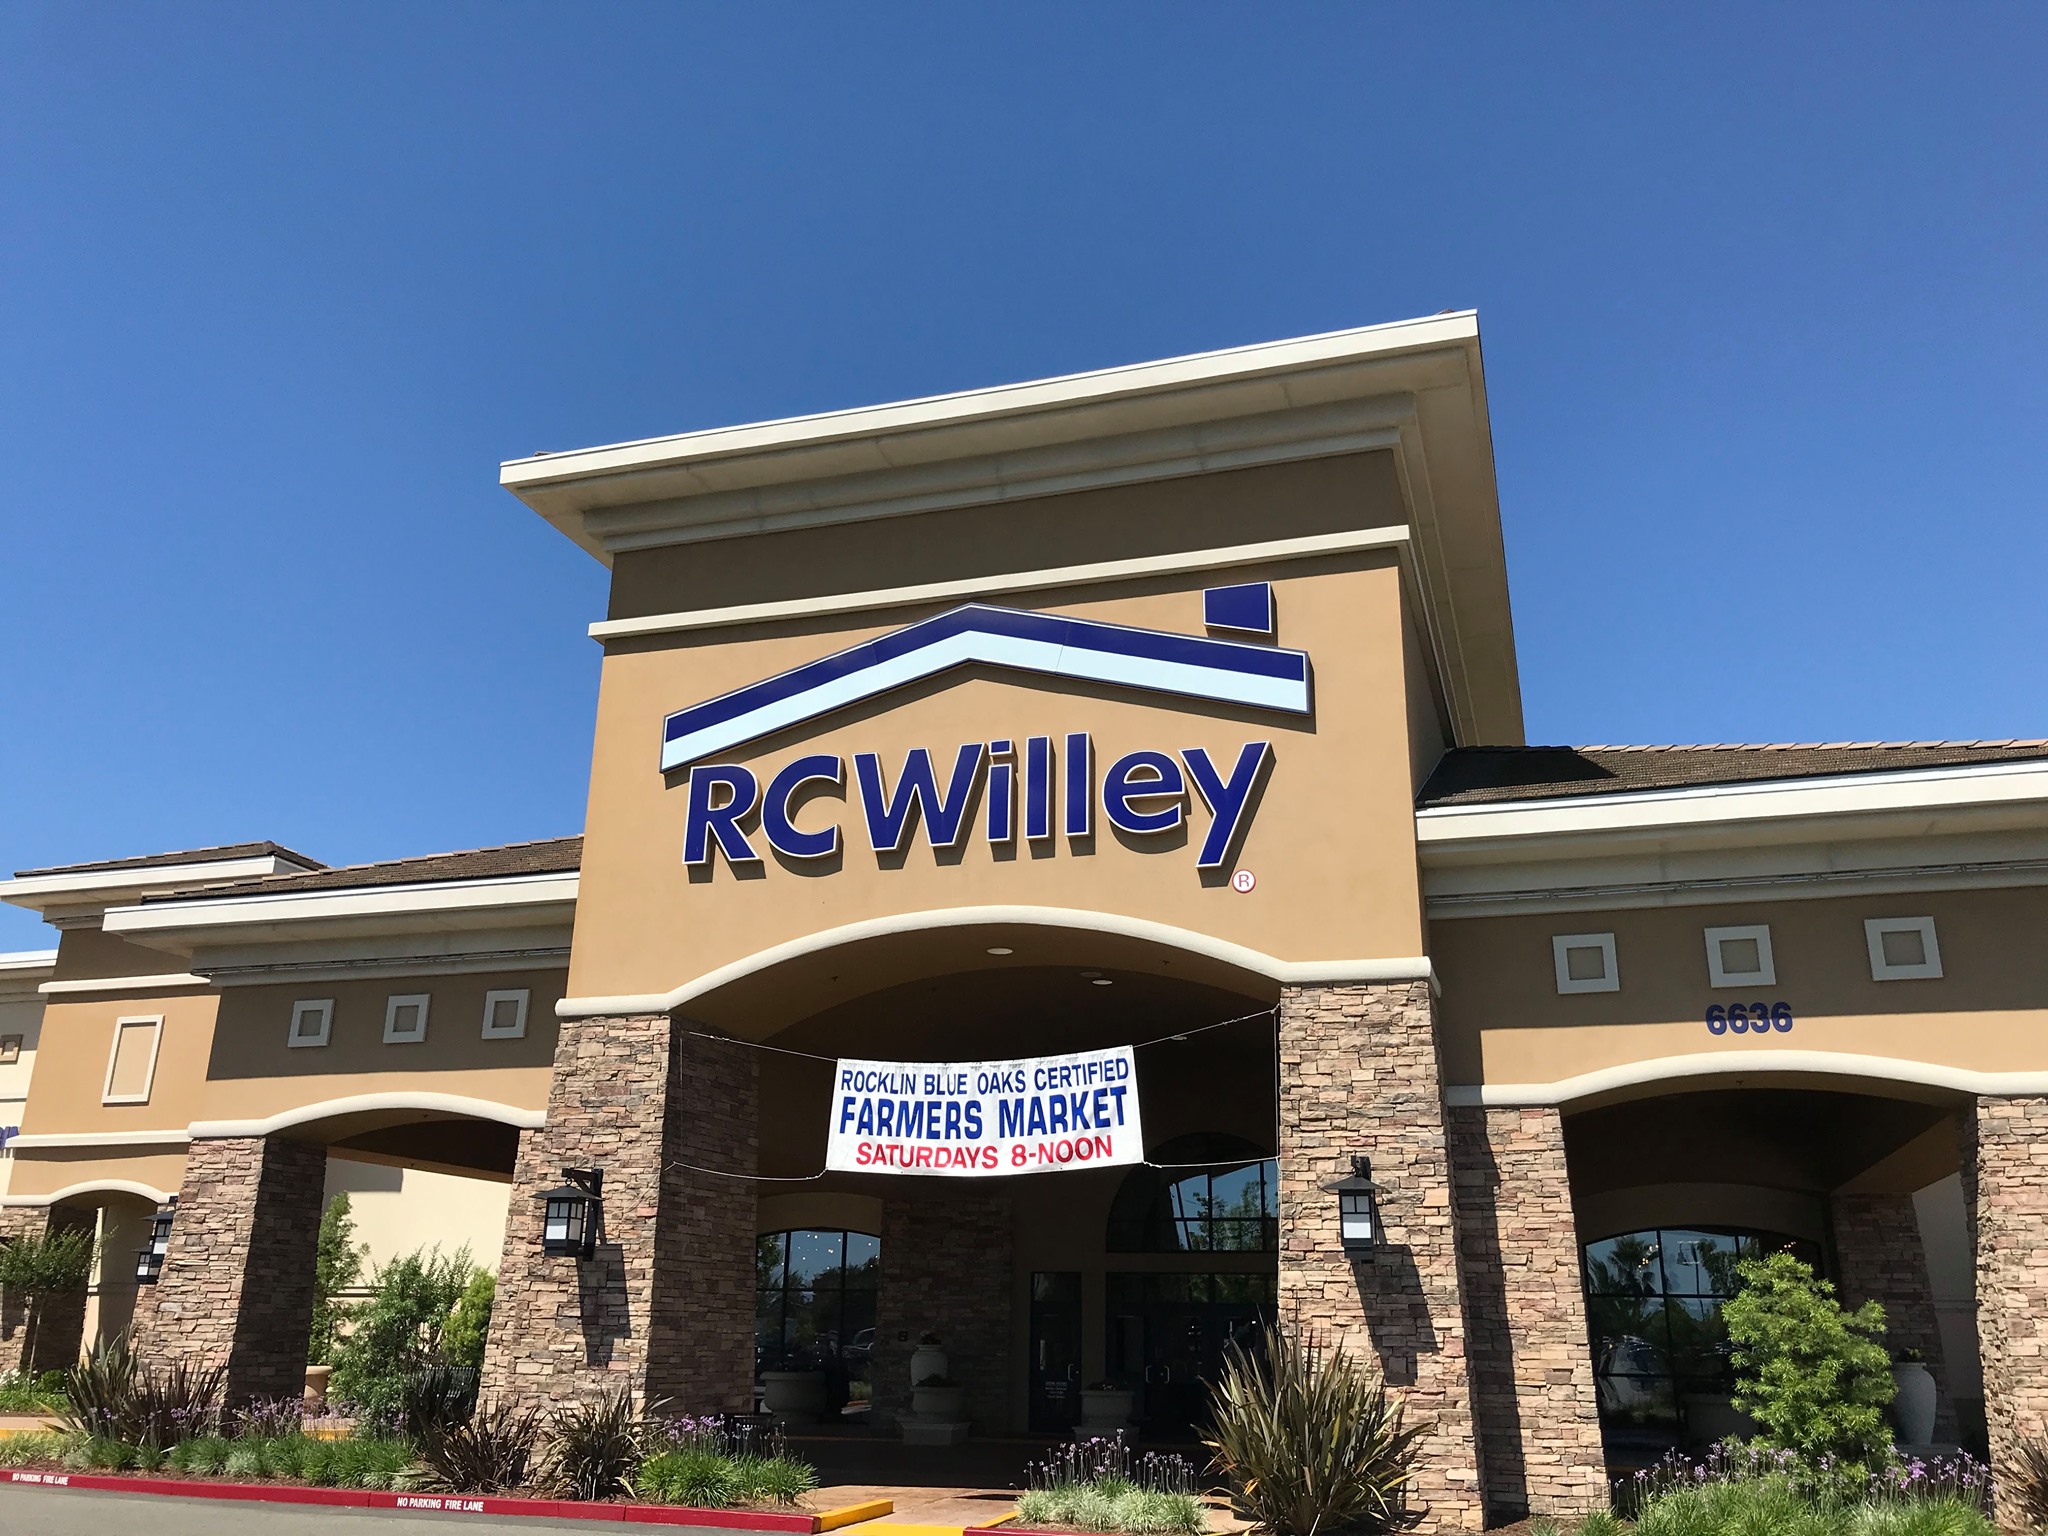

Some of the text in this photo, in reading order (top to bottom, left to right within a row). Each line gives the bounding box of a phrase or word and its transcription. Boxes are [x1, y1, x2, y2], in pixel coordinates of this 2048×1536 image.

[1705, 1001, 1793, 1036] 6636
[841, 1057, 1129, 1096] ROCKLIN BLUE OAKS CERTIFIED
[839, 1085, 1127, 1140] FARMERS MARKET
[855, 1134, 1113, 1170] SATURDAYS 8-NOON
[43, 1474, 55, 1484] FIRE
[54, 1476, 69, 1486] LANE
[396, 1497, 484, 1512] NO PARKING FIRE LANE
